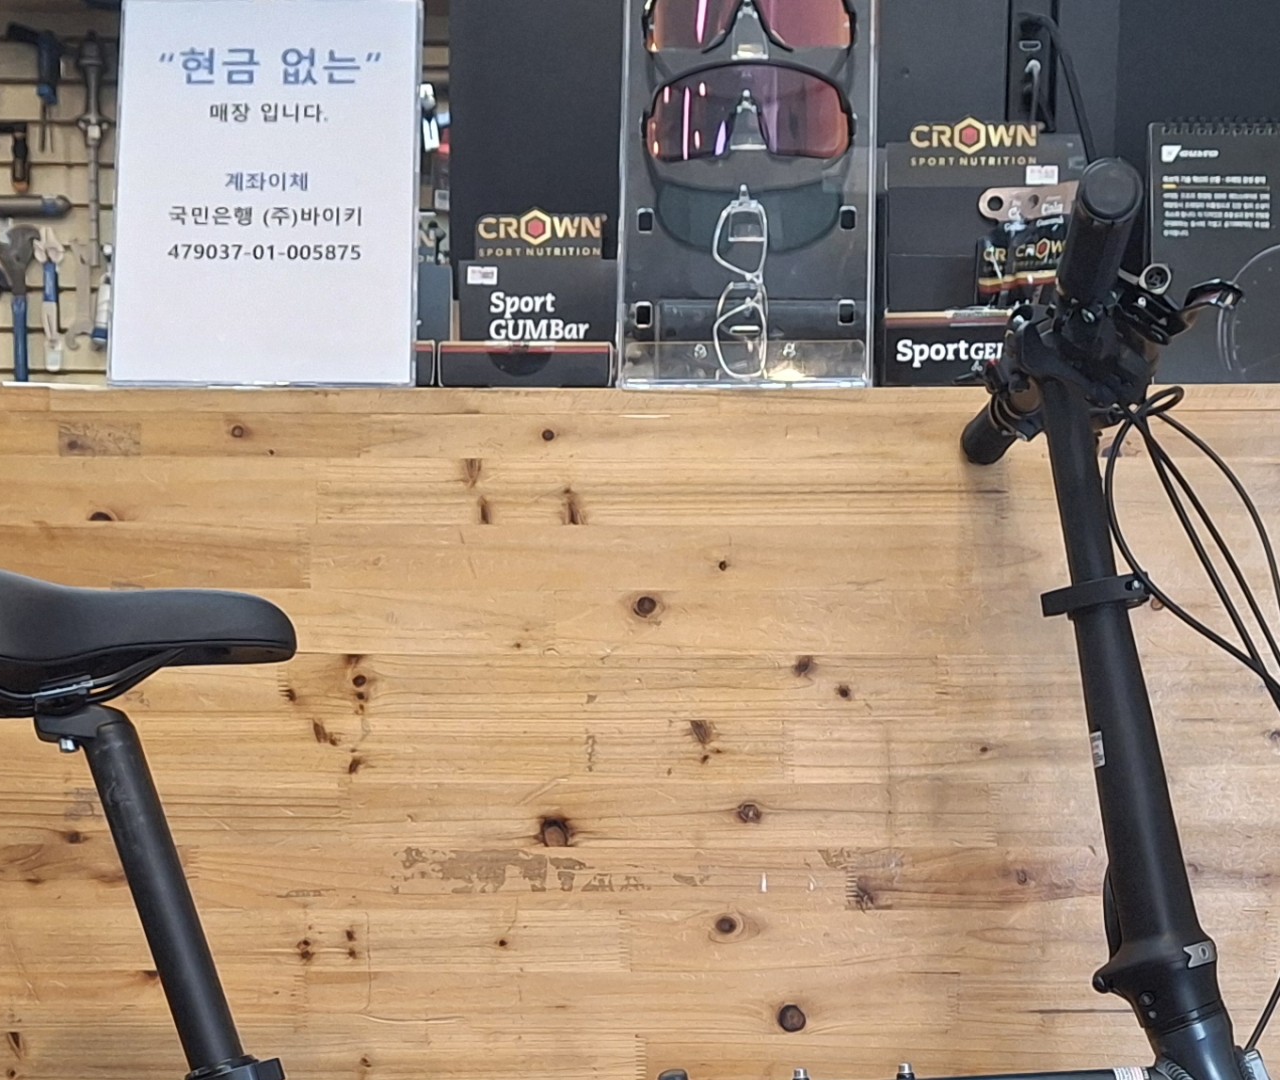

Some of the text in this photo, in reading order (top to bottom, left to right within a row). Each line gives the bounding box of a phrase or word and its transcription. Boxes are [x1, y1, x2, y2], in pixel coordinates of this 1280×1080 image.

[209, 103, 330, 124] 매장 입니다.
[910, 117, 1038, 155] CROWN
[910, 156, 1037, 166] SPORT NUTRITION
[225, 172, 309, 191] 계좌이체
[169, 206, 362, 227] 국민은행 (주)바이키
[477, 209, 602, 246] CROWN
[167, 244, 361, 261] 479037-01-005875
[478, 247, 602, 258] SPORT NUTRITION
[490, 291, 556, 319] Sport
[489, 319, 590, 341] GUMBar
